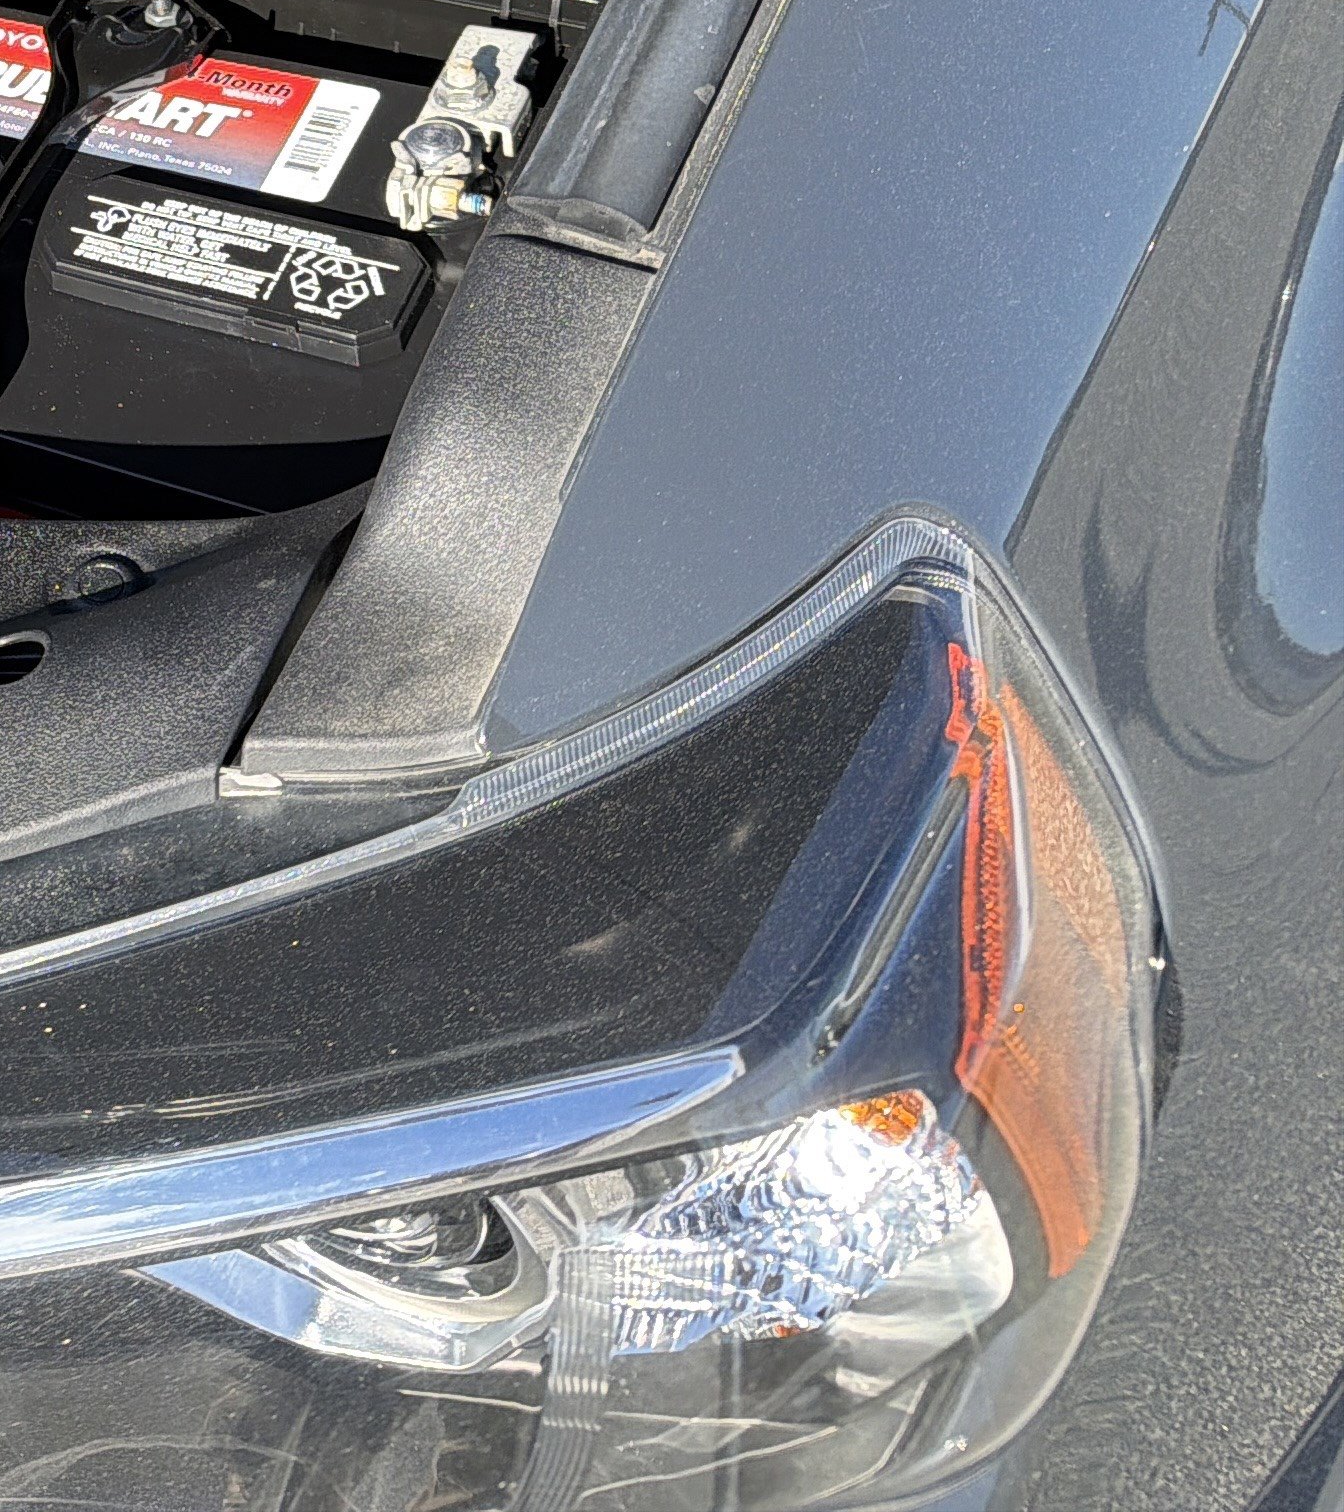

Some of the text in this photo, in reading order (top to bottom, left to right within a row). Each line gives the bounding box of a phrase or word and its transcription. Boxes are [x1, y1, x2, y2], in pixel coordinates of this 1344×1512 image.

[153, 136, 173, 148] RC
[163, 154, 196, 168] Texas
[197, 161, 233, 176] 75024
